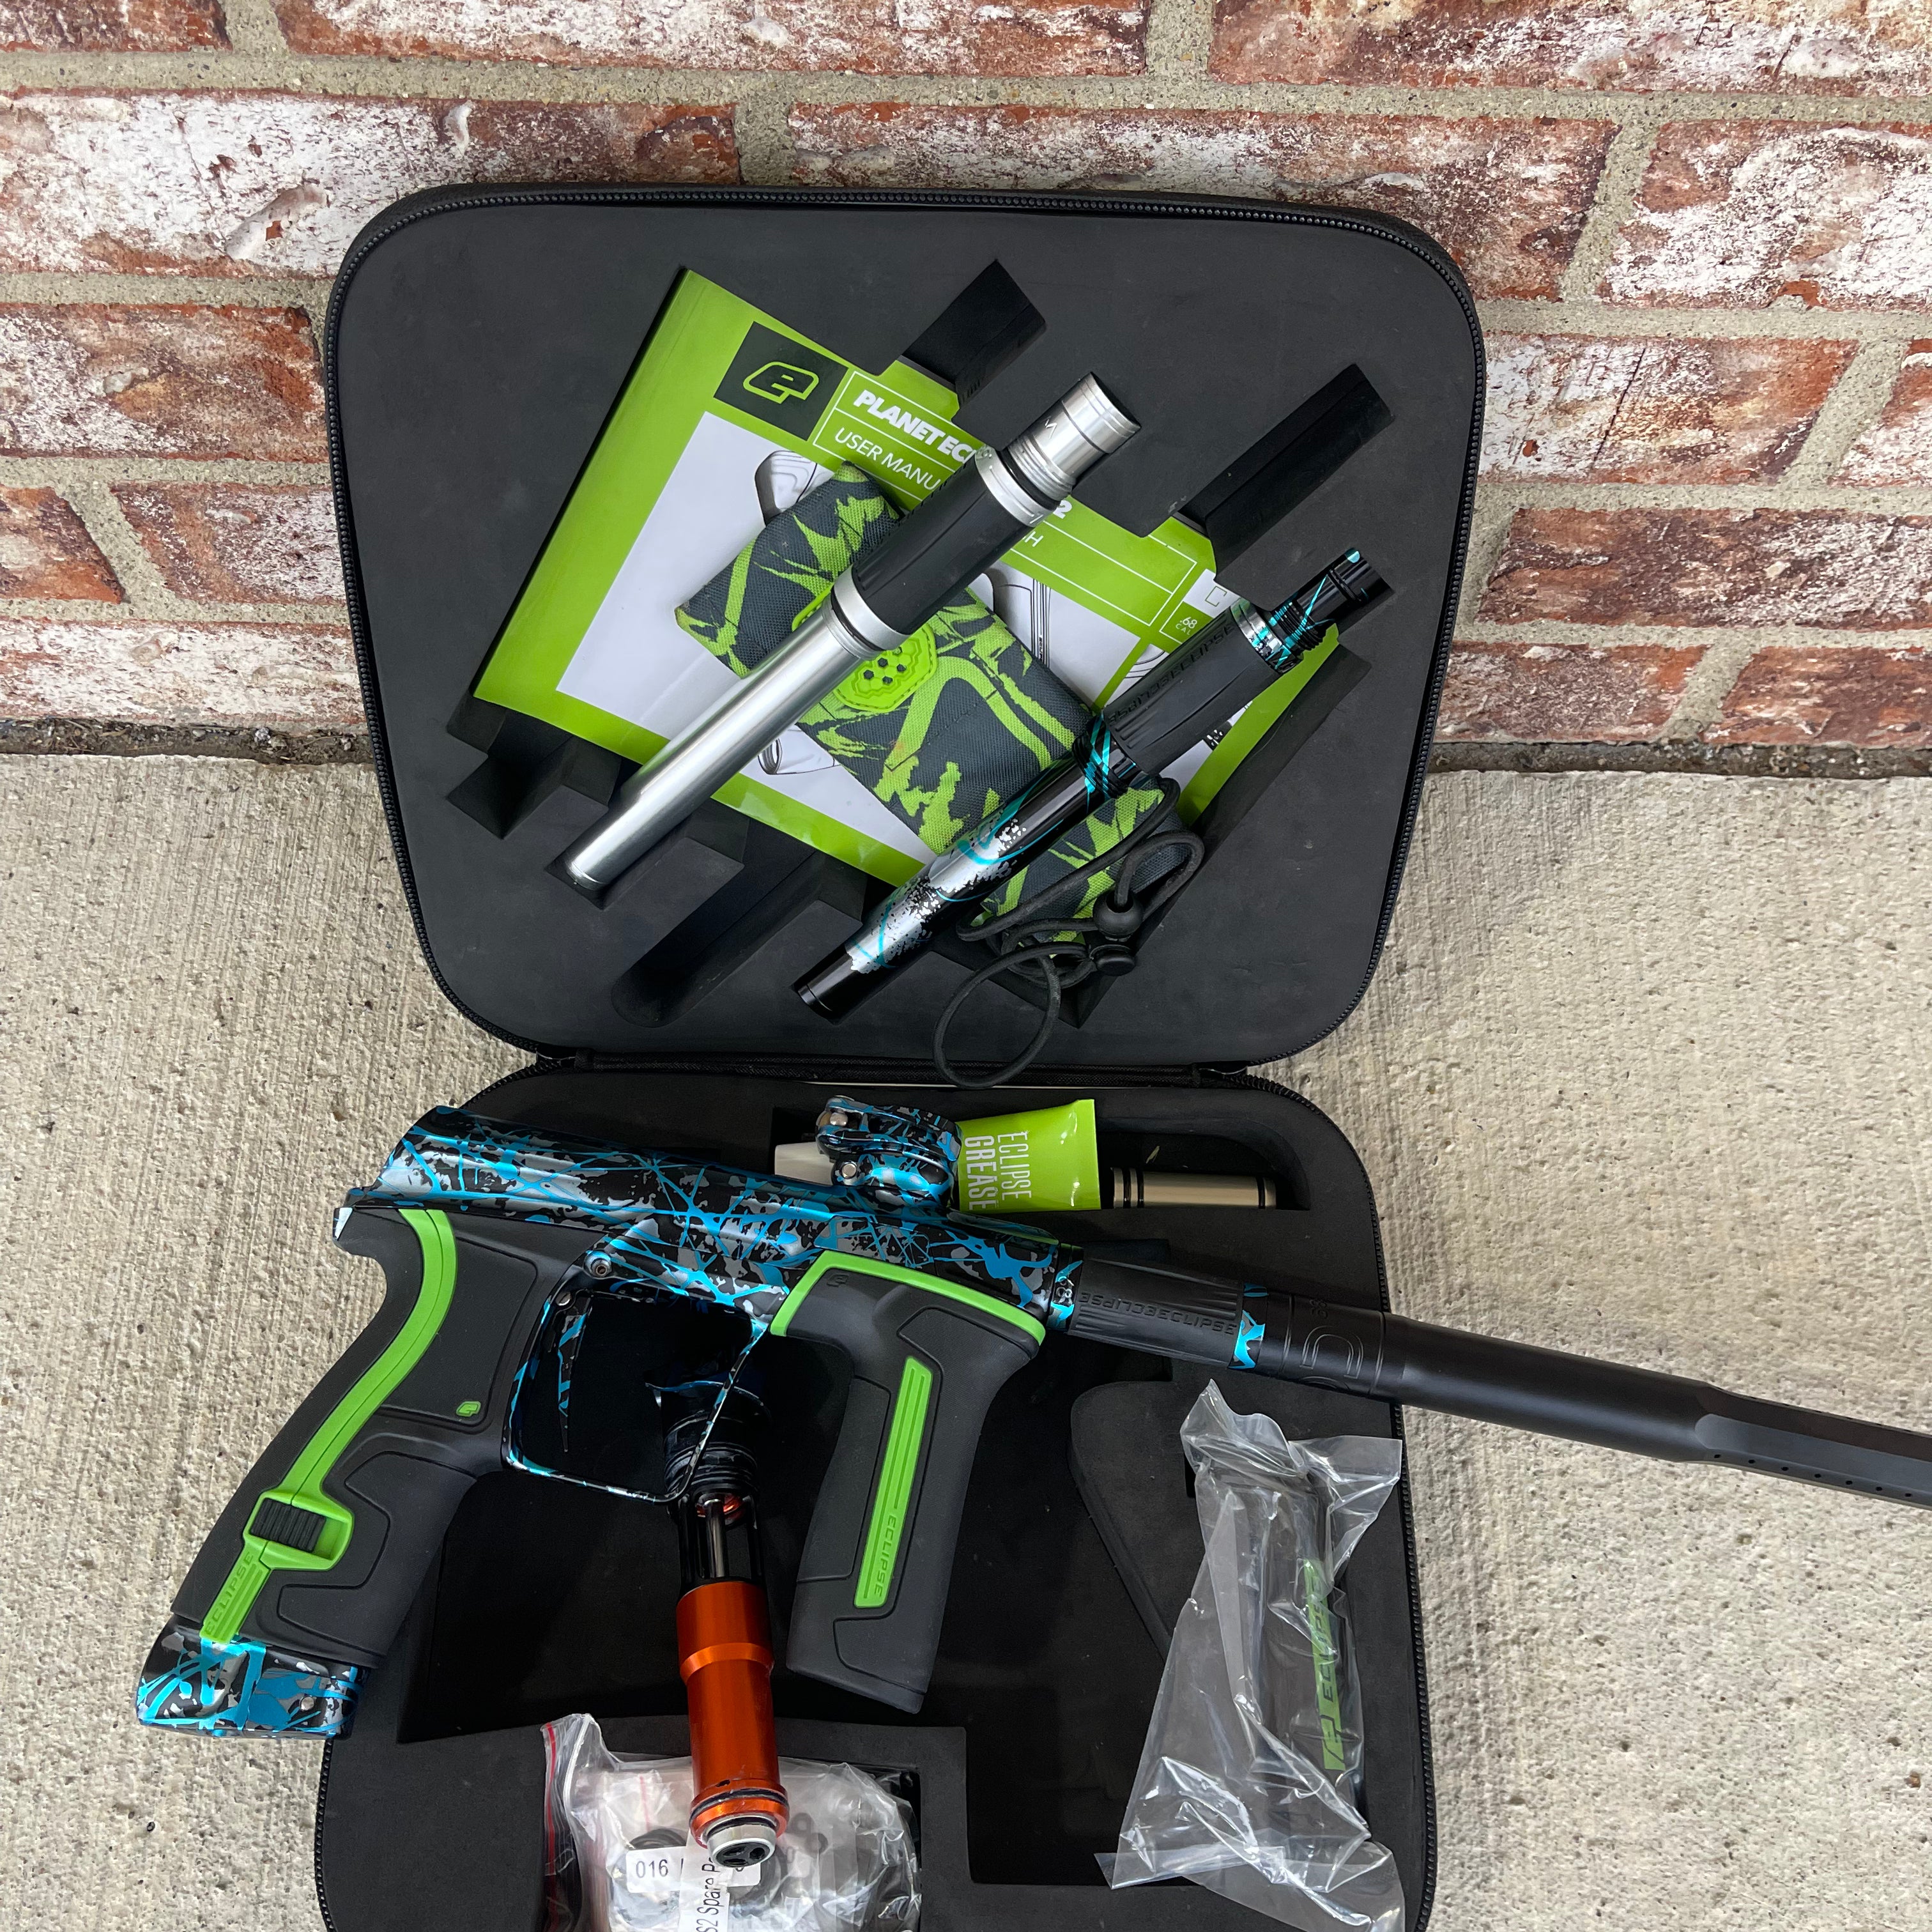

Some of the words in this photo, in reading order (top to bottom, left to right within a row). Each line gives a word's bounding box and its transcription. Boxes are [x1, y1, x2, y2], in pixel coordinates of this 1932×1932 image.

[834, 427, 884, 461] USER
[853, 389, 946, 446] PLANET
[1175, 623, 1192, 636] CAL
[964, 1135, 999, 1211] GREASE
[997, 1131, 1032, 1201] ECLIPSE
[1156, 1309, 1238, 1336] ECLIPSE
[873, 1514, 897, 1598] ECLIPSE
[204, 1551, 254, 1636] ECLIPSE
[636, 1859, 669, 1878] 016
